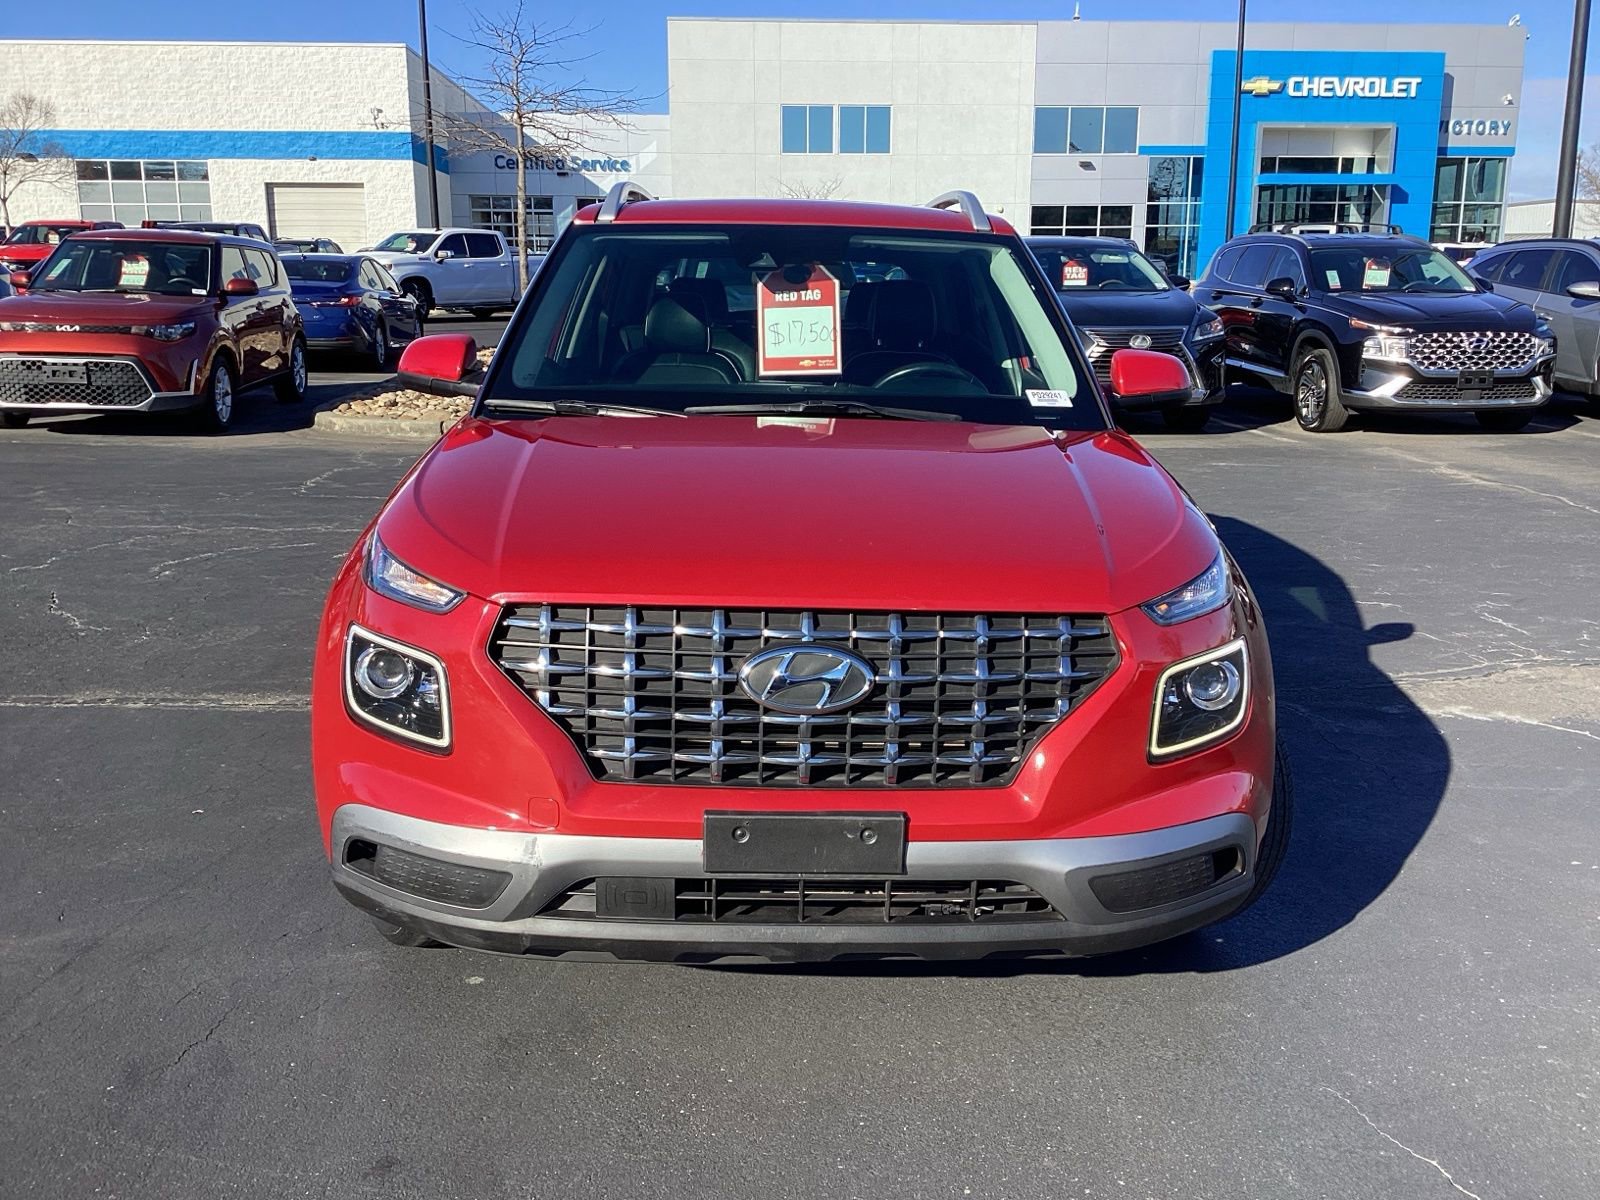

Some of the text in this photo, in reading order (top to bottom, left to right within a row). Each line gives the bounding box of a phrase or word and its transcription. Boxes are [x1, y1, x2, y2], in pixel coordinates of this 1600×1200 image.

[1287, 77, 1422, 98] CHEVROLET
[571, 155, 630, 172] Service
[775, 289, 821, 302] RED TAG
[768, 320, 838, 346] $17,500
